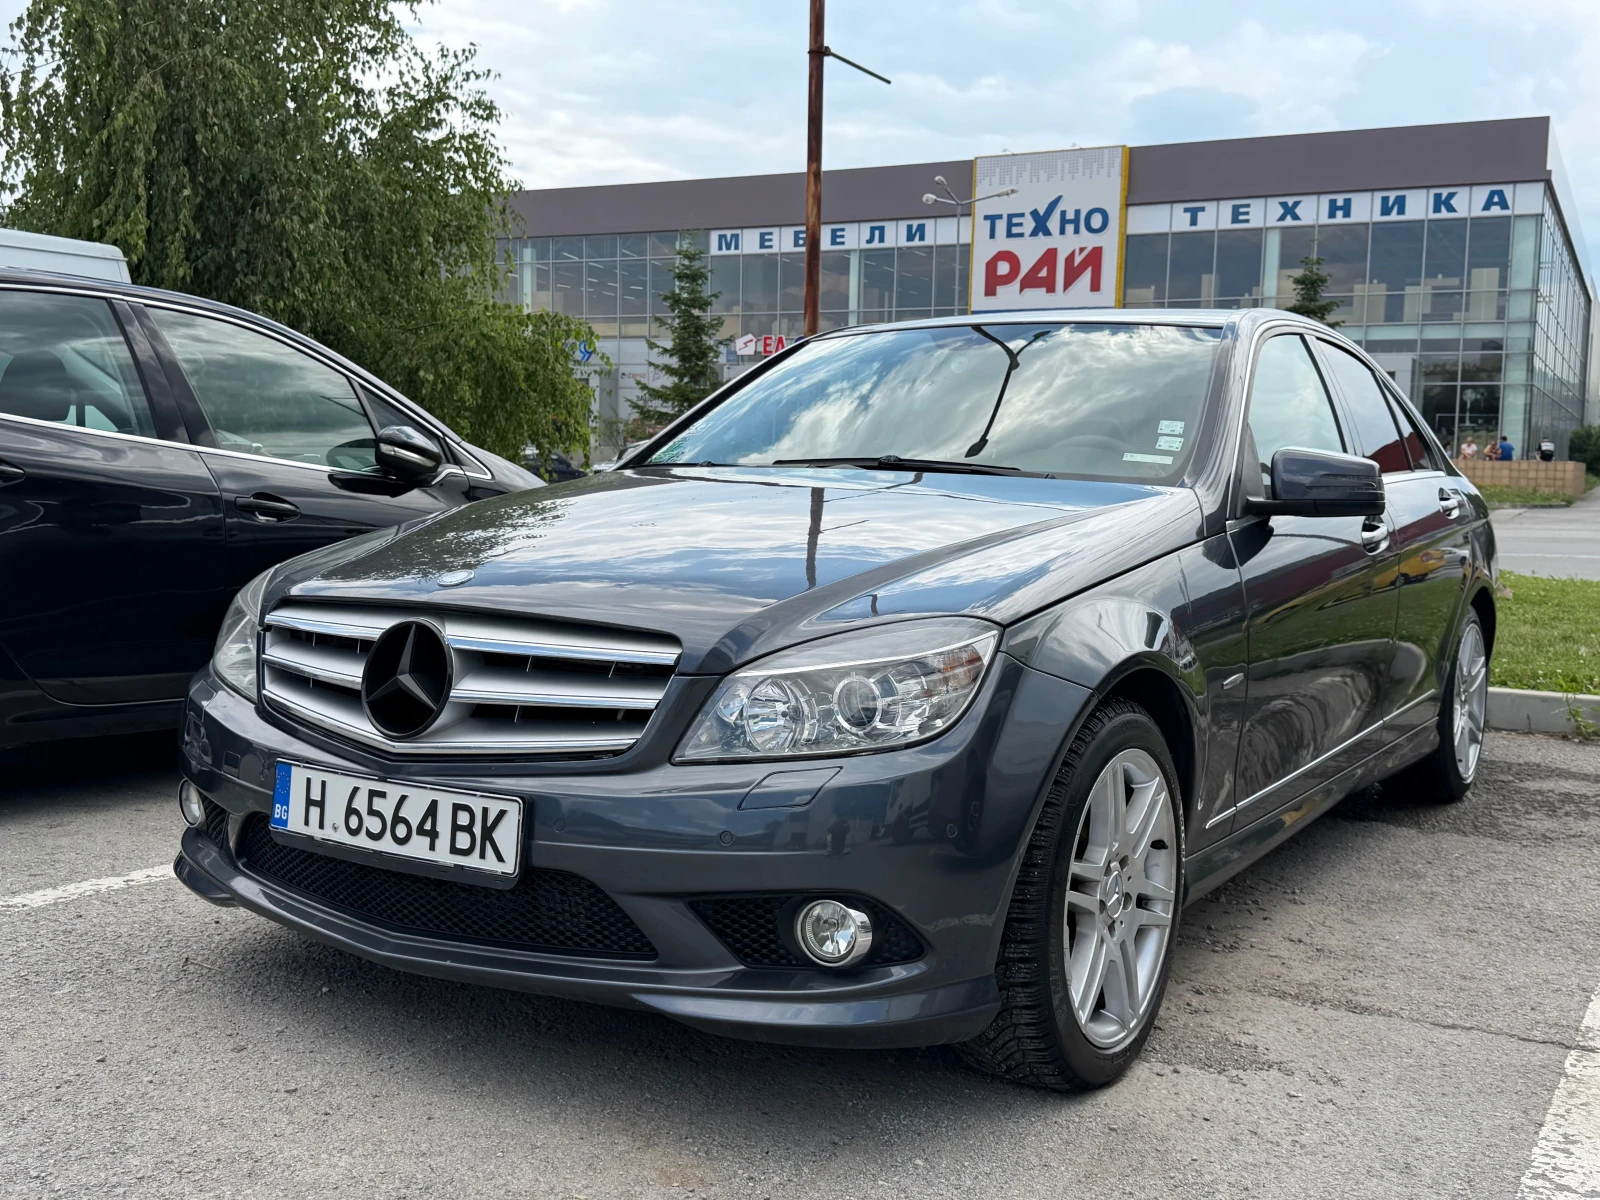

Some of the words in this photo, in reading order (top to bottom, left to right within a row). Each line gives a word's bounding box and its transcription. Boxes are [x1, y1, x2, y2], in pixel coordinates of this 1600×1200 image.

[983, 195, 1109, 239] ТЕХНО
[1183, 189, 1510, 227] ТЕХНИКА
[717, 223, 926, 251] МЕБЕЛИ
[984, 246, 1103, 297] РАЙ
[274, 803, 288, 820] BG
[304, 777, 327, 830] H
[344, 785, 440, 852] 6564
[449, 802, 508, 863] BK
